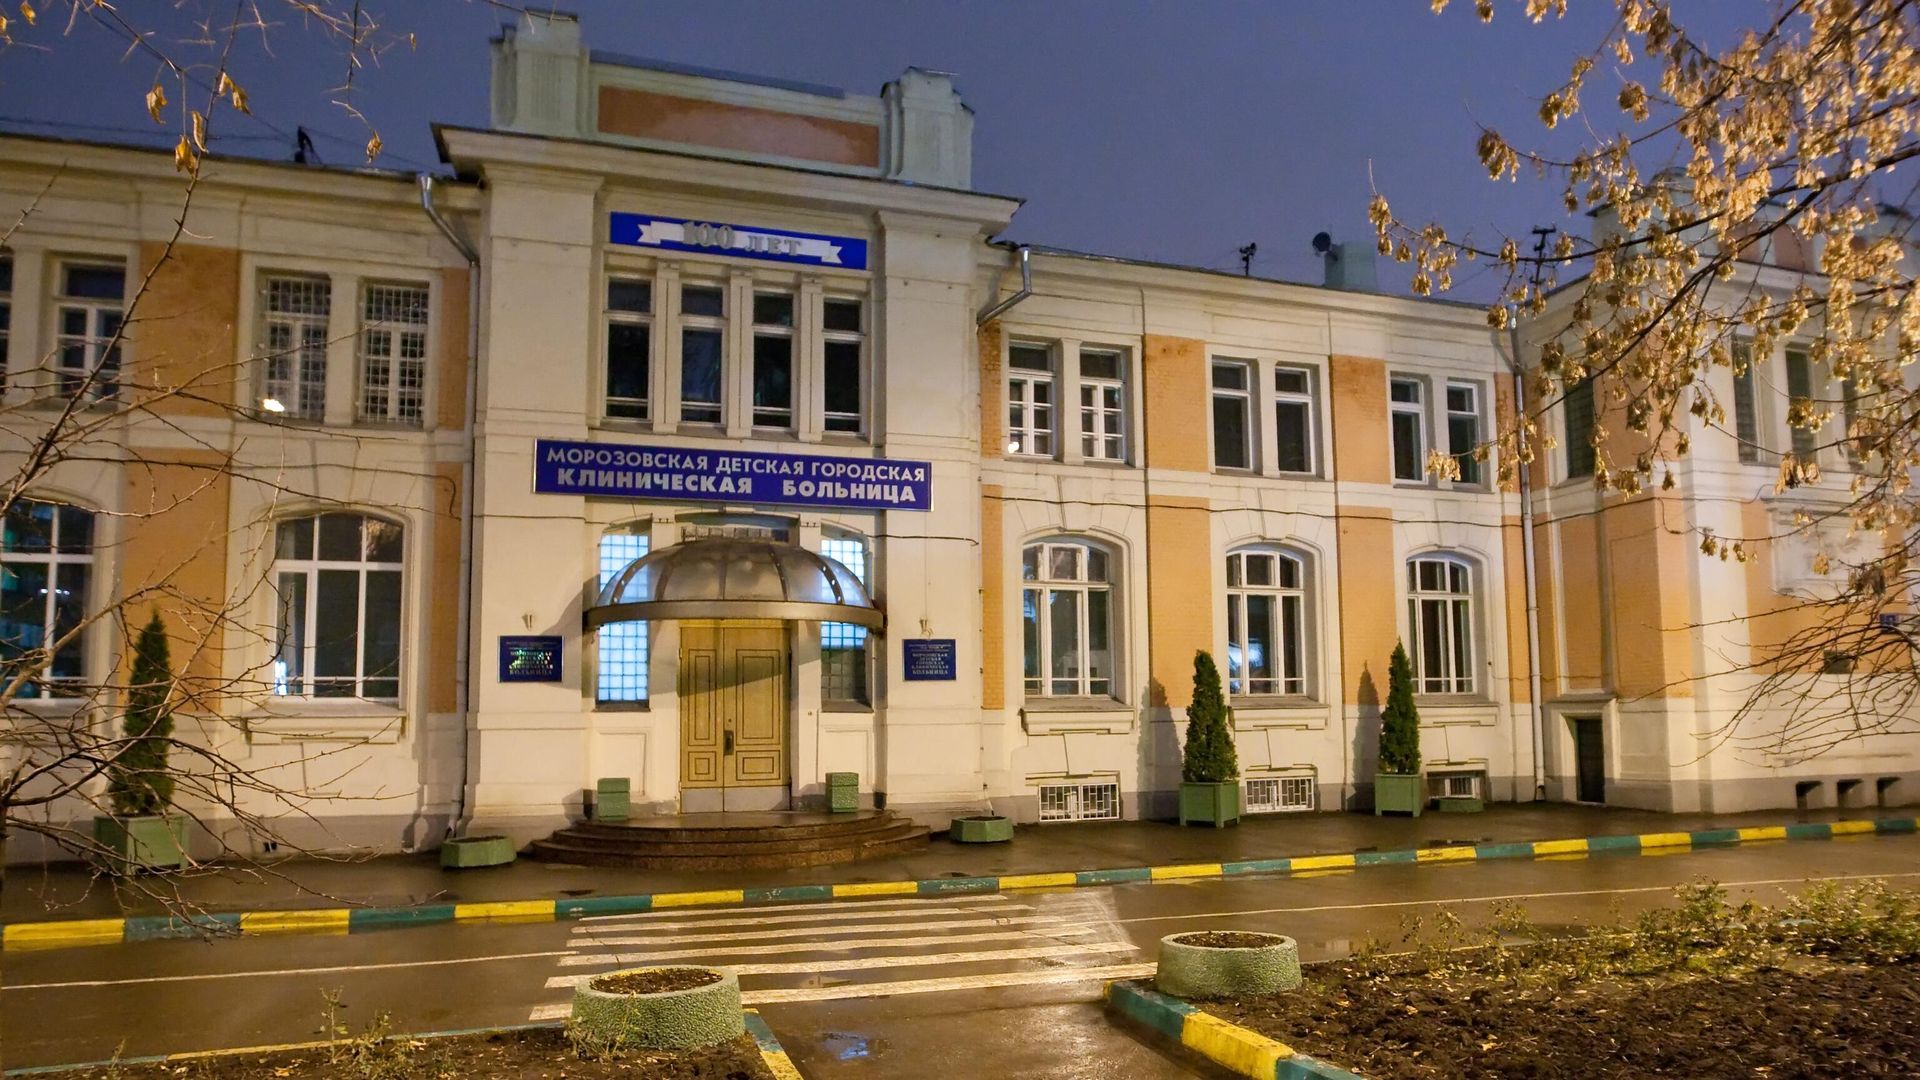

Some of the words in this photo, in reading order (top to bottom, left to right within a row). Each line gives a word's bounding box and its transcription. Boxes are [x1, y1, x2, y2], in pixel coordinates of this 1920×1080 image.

[681, 221, 735, 250] 100
[745, 234, 801, 256] ЛЕТ
[547, 447, 708, 470] МОРОЗОВСКАЯ
[716, 457, 804, 475] ДЕТСКАЯ
[811, 462, 925, 482] ГОРОДСКАЯ
[557, 468, 752, 494] КЛИНИЧЕСКАЯ
[782, 480, 916, 503] БОЛЬНИЦА
